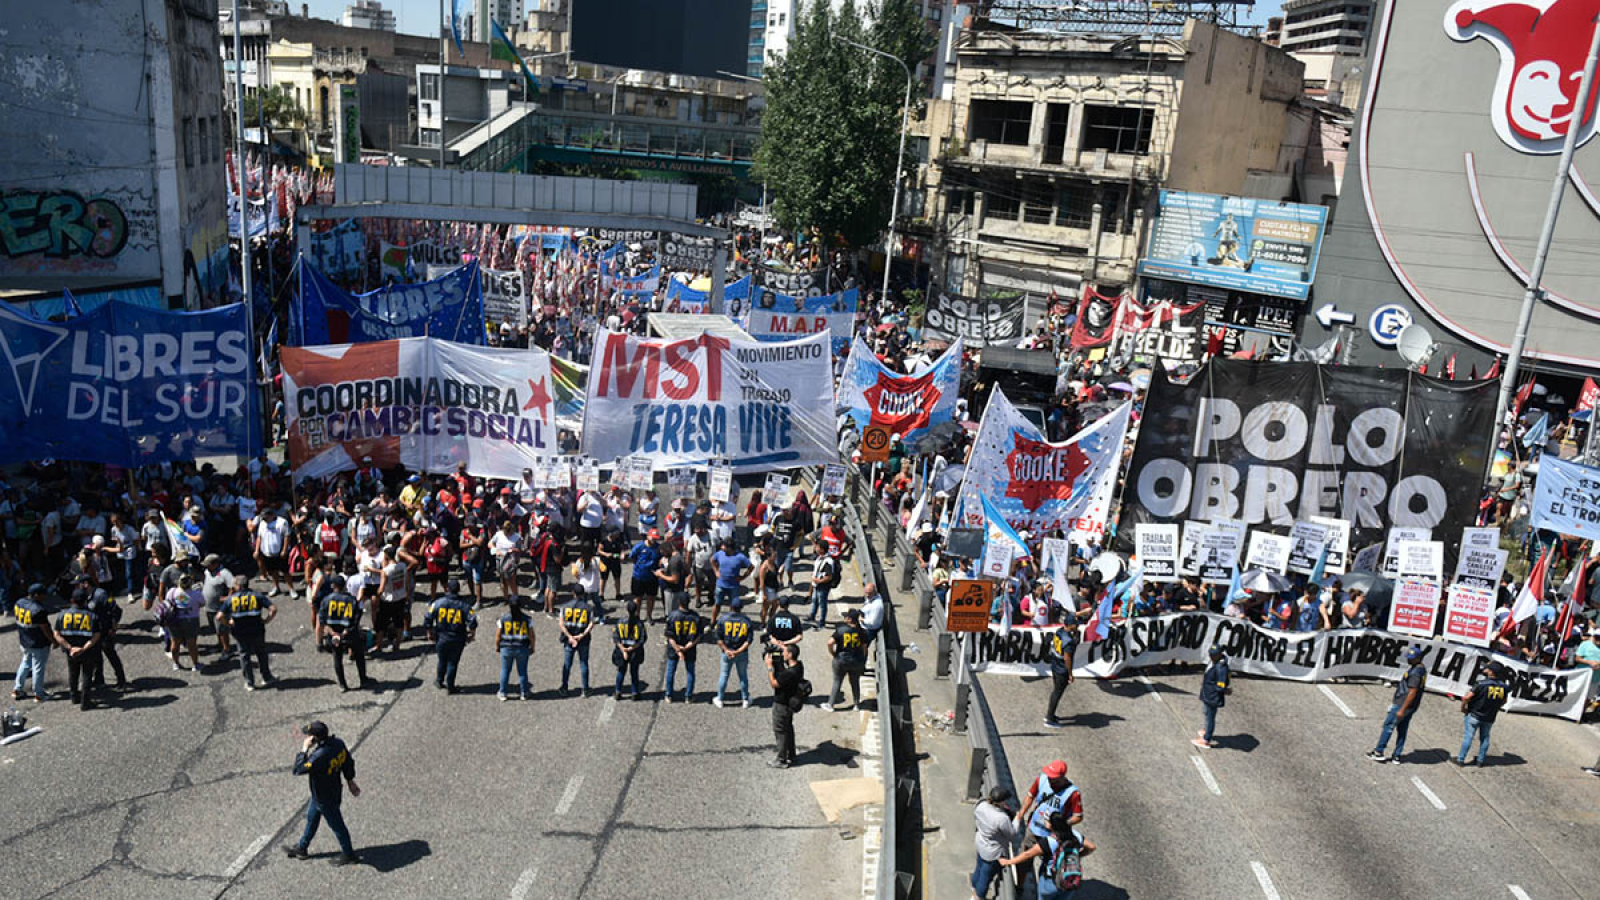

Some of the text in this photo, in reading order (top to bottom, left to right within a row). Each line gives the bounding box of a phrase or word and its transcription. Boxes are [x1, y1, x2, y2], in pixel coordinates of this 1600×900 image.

[0, 188, 128, 259] ERO
[599, 229, 653, 241] OBRERO
[412, 244, 460, 265] MULCS
[482, 275, 522, 297] ULCS
[764, 271, 813, 289] POLO
[359, 277, 465, 326] LIBRES
[938, 294, 1003, 319] POLO
[926, 308, 1014, 339] OBRERO
[71, 330, 248, 382] LIBRES
[736, 343, 822, 365] MOVIMIENTO
[597, 332, 731, 402] MST
[67, 380, 246, 428] DEL SUR
[296, 376, 520, 419] COORDINADORA
[877, 388, 925, 416] COOKE
[299, 416, 324, 437] POR
[447, 406, 547, 449] SOCIAL
[629, 403, 727, 455] TERESA
[739, 402, 792, 452] VIVE
[1193, 397, 1406, 467] POLO
[310, 434, 324, 449] EL
[869, 432, 885, 447] 20
[1013, 449, 1067, 481] COOKE
[1137, 457, 1448, 530] OBRERO
[1550, 502, 1567, 517] EL
[1067, 518, 1105, 537] TEJA
[231, 595, 259, 612] PFA
[328, 600, 353, 619] PFA
[14, 605, 32, 625] PFA
[63, 613, 91, 631] PFA
[438, 607, 462, 625] PFA
[564, 607, 587, 624] PFA
[775, 617, 793, 630] PFA
[504, 621, 529, 637] PFA
[675, 620, 697, 636] PFA
[724, 622, 748, 638] PFA
[1131, 614, 1208, 657] SALARIO
[1214, 619, 1287, 662] CONTRA
[1292, 638, 1316, 668] EL
[1323, 634, 1408, 668] HAMBRE
[1431, 647, 1467, 682] LA
[1468, 652, 1569, 703] PBREZA
[1488, 685, 1505, 700] PFA
